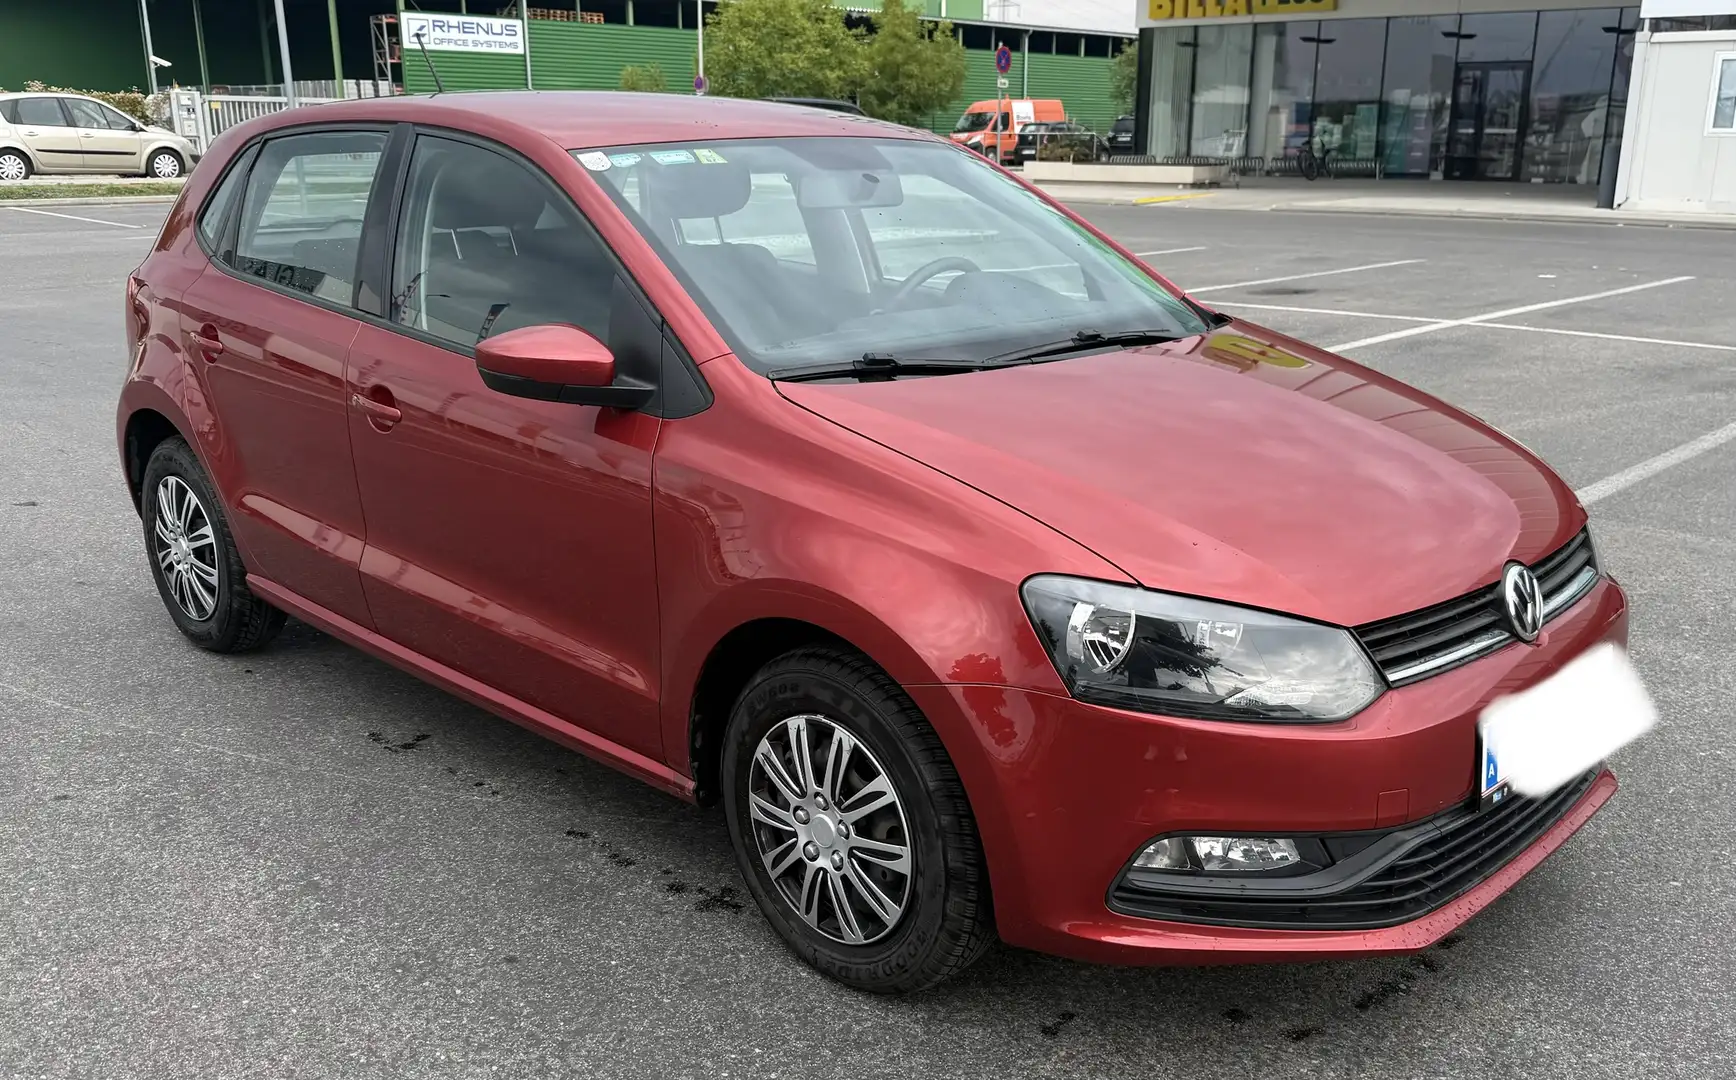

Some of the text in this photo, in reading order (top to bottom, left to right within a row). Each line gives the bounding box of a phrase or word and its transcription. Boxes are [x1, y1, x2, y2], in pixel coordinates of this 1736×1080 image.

[432, 19, 518, 37] RHENUS
[433, 37, 519, 50] OFFICE SYSTEMS
[1488, 763, 1495, 779] A
